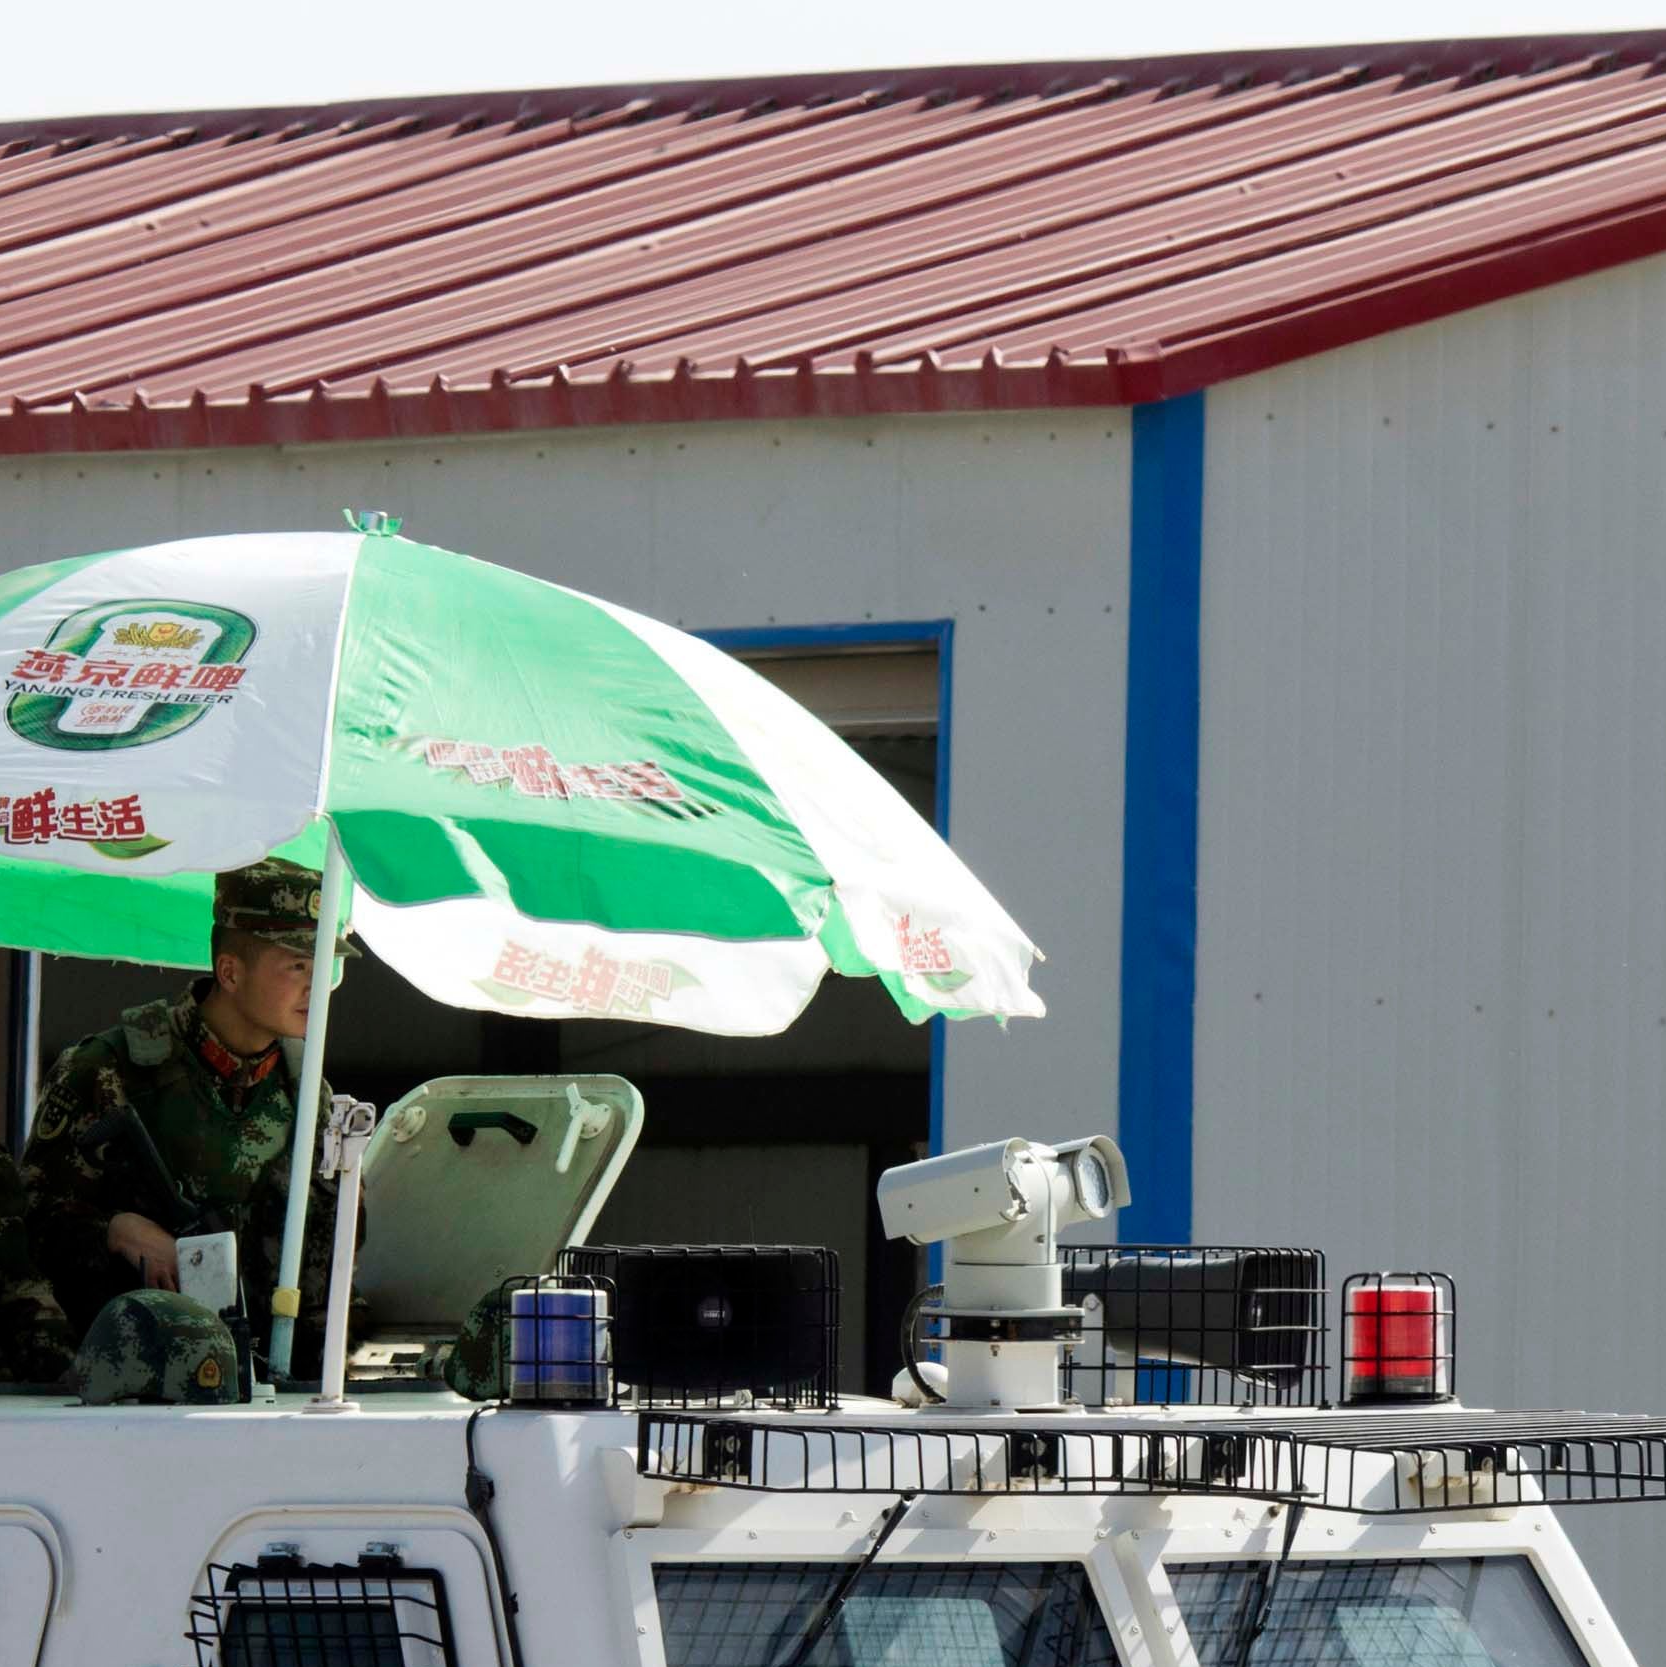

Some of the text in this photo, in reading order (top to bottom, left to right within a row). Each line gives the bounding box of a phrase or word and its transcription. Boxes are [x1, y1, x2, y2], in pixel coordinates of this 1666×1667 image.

[11, 650, 247, 691] 燕京鲜啤
[3, 679, 233, 704] YANJING FRESH BEER
[11, 786, 145, 841] 鲜生活
